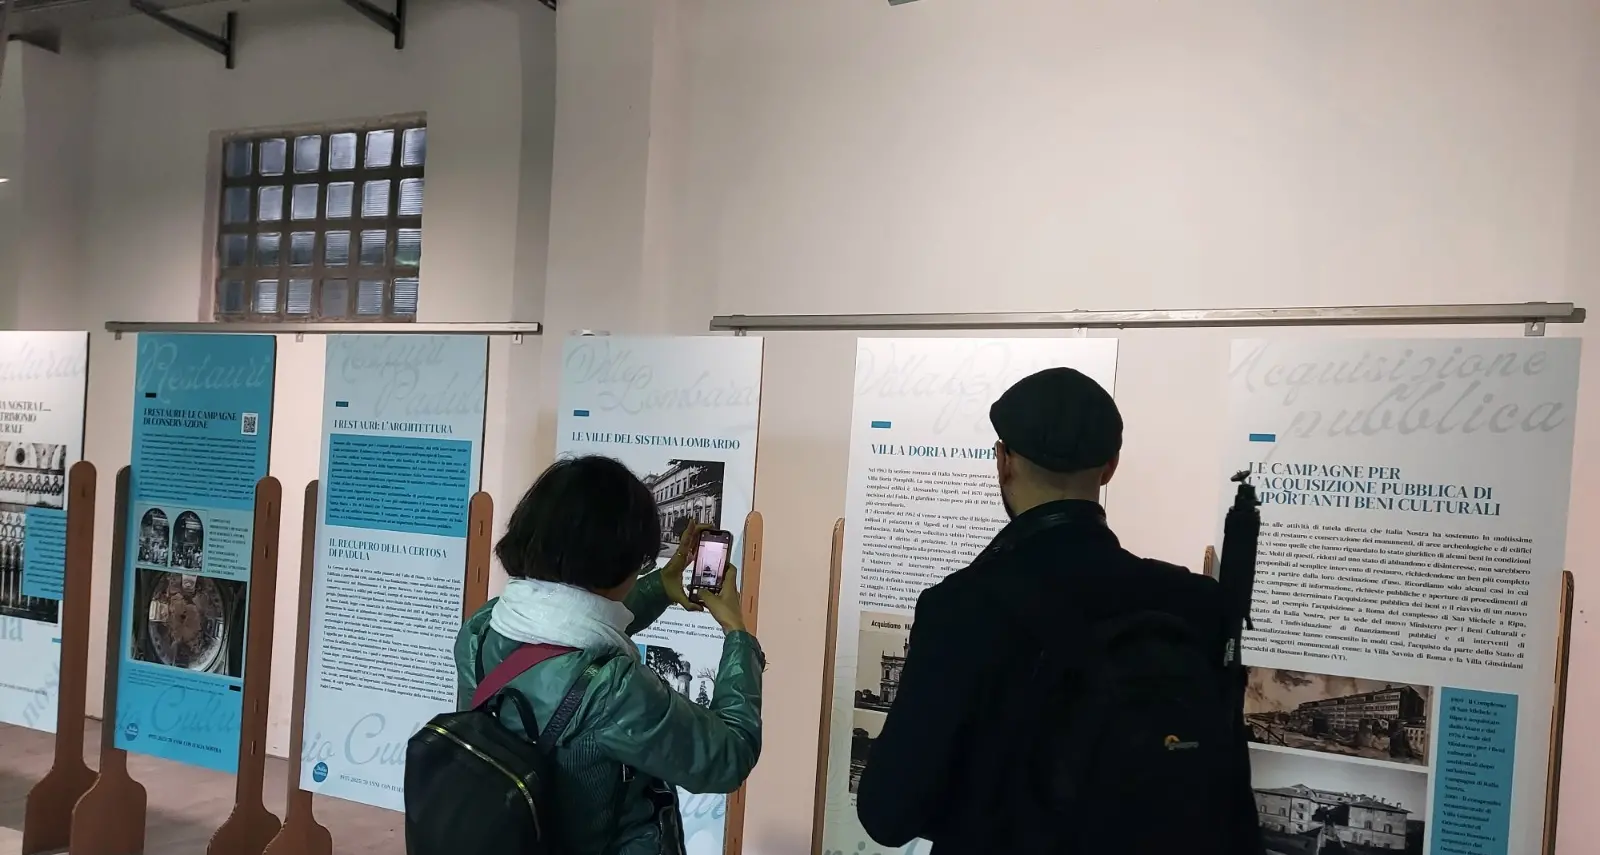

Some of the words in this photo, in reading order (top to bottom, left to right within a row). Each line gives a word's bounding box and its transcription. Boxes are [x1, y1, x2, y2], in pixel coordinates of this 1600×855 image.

[1229, 343, 1548, 406] Acquisizione
[198, 411, 236, 420] CAMPAGNE
[1264, 380, 1566, 463] pubblica
[152, 418, 208, 429] CONSERVAZIONE
[334, 420, 337, 428] I
[381, 421, 453, 434] L'ARCHITETTURA
[572, 432, 585, 441] LE
[586, 432, 612, 443] VILLE
[614, 434, 633, 443] DEL
[635, 434, 678, 447] SISTEMA
[680, 437, 740, 450] LOMBARDO
[872, 443, 904, 455] VILLA
[908, 445, 947, 457] DORIA
[950, 447, 996, 459] PAMPH
[1248, 461, 1267, 475] LE
[1271, 462, 1364, 479] CAMPAGNE
[1368, 466, 1400, 480] PER
[1381, 482, 1468, 500] PUBBLICA
[1473, 486, 1492, 500] DI
[1257, 491, 1350, 508] MPORTANTI
[1354, 494, 1393, 510] BENI
[1398, 497, 1501, 516] CULTURALI
[329, 538, 337, 547] IL
[338, 539, 380, 551] RECUPERO
[381, 543, 408, 554] DELLA
[408, 545, 447, 558] CERTOSA
[329, 548, 337, 557] DI
[338, 549, 370, 561] PADULA
[1443, 543, 1492, 552] archeologiche
[1329, 564, 1363, 572] intervento
[1405, 570, 1454, 579] richiedendone
[1338, 575, 1378, 584] destinazione
[1404, 580, 1444, 589] Ricordiamo
[1293, 591, 1332, 600] determinato
[1334, 594, 1378, 604] l'acquisizione
[1471, 597, 1518, 605] procedimenti
[1280, 619, 1332, 629] L'individuazione
[1354, 626, 1400, 635] finanziamenti
[1474, 637, 1509, 646] interventi
